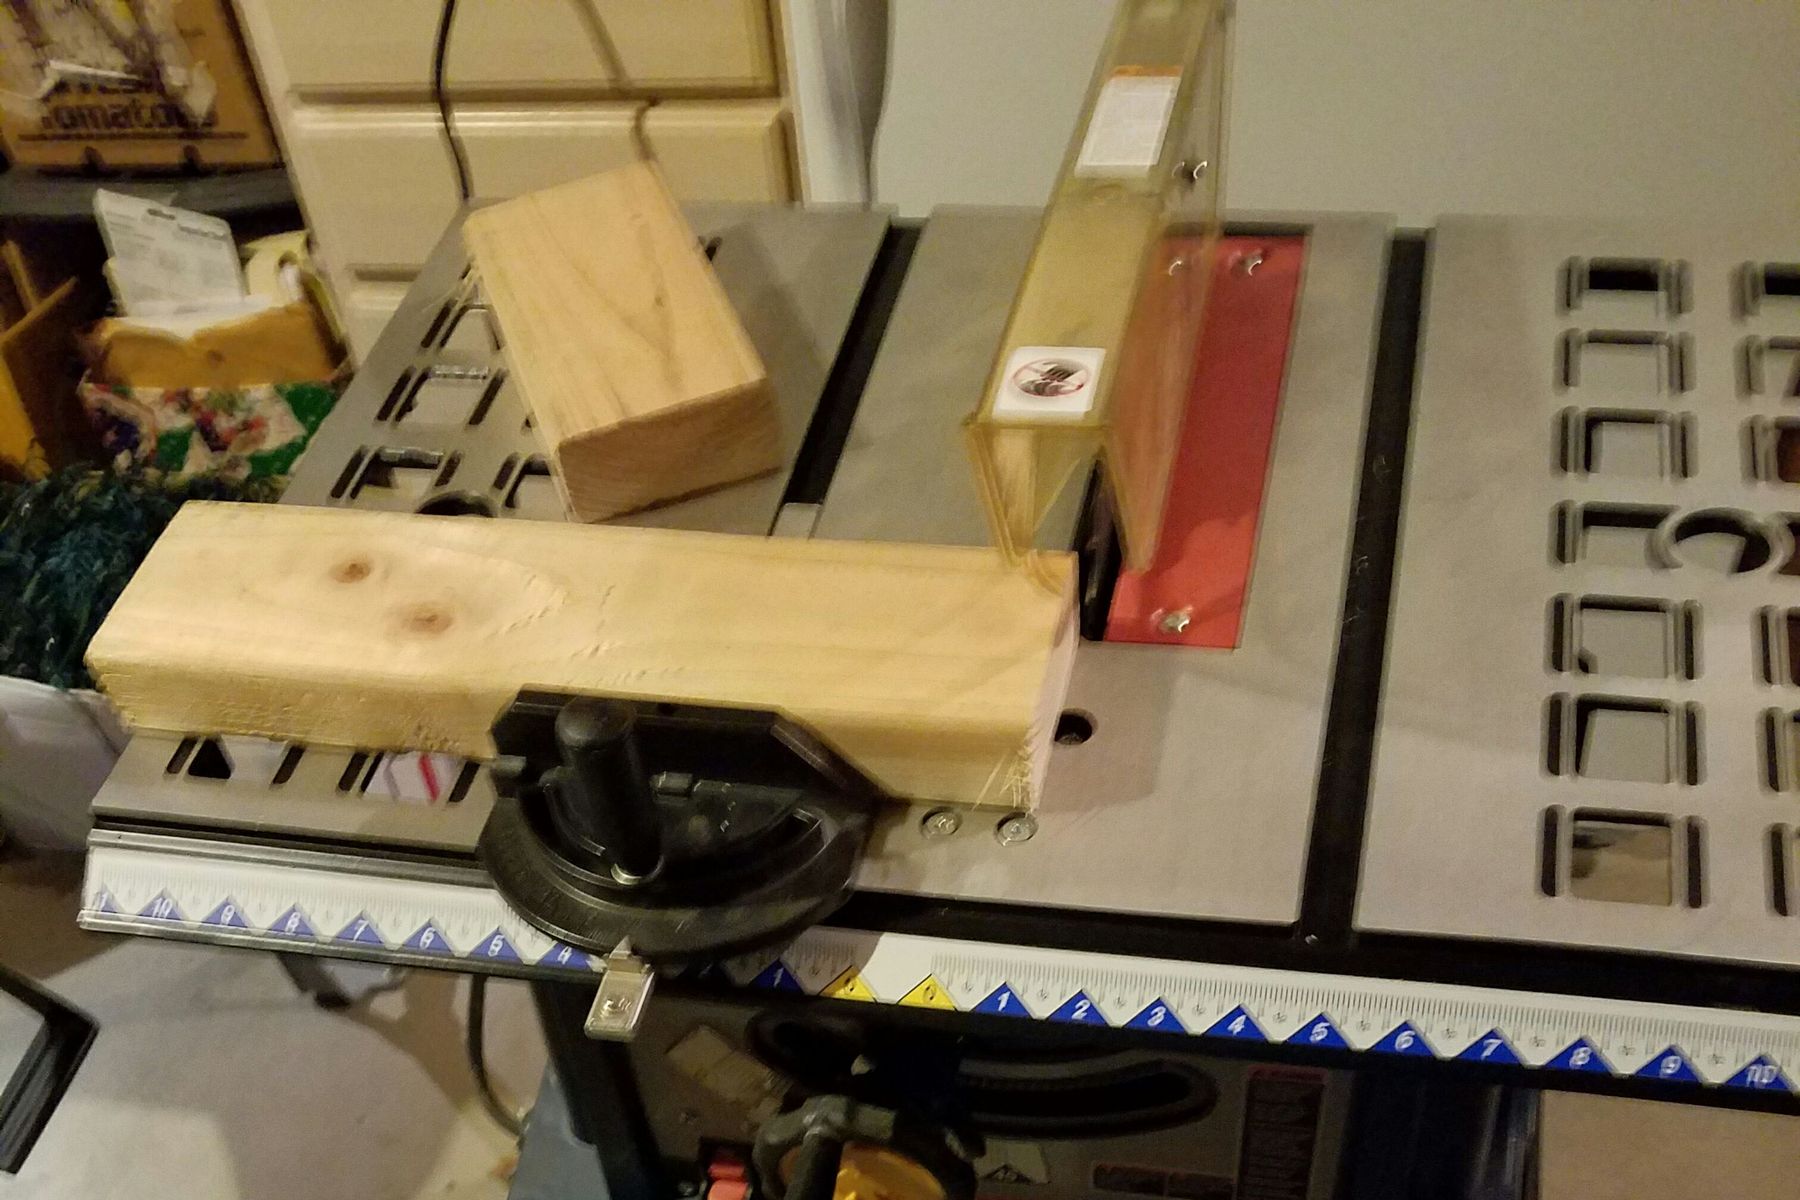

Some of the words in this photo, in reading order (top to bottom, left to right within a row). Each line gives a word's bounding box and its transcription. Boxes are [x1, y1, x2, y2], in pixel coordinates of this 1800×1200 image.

[284, 912, 300, 934] 8
[352, 919, 369, 941] 7
[419, 927, 436, 949] 6
[488, 935, 505, 957] 5
[557, 946, 573, 965] 4
[997, 991, 1011, 1011] 1
[1071, 999, 1090, 1020] 2
[1147, 1006, 1166, 1027] 3
[1227, 1014, 1247, 1035] 4
[1309, 1022, 1330, 1043] 5
[1395, 1030, 1415, 1051] 6
[1481, 1038, 1503, 1060] 7
[1569, 1046, 1591, 1068] 8
[1660, 1055, 1682, 1078] 9
[1746, 1064, 1780, 1088] 10
